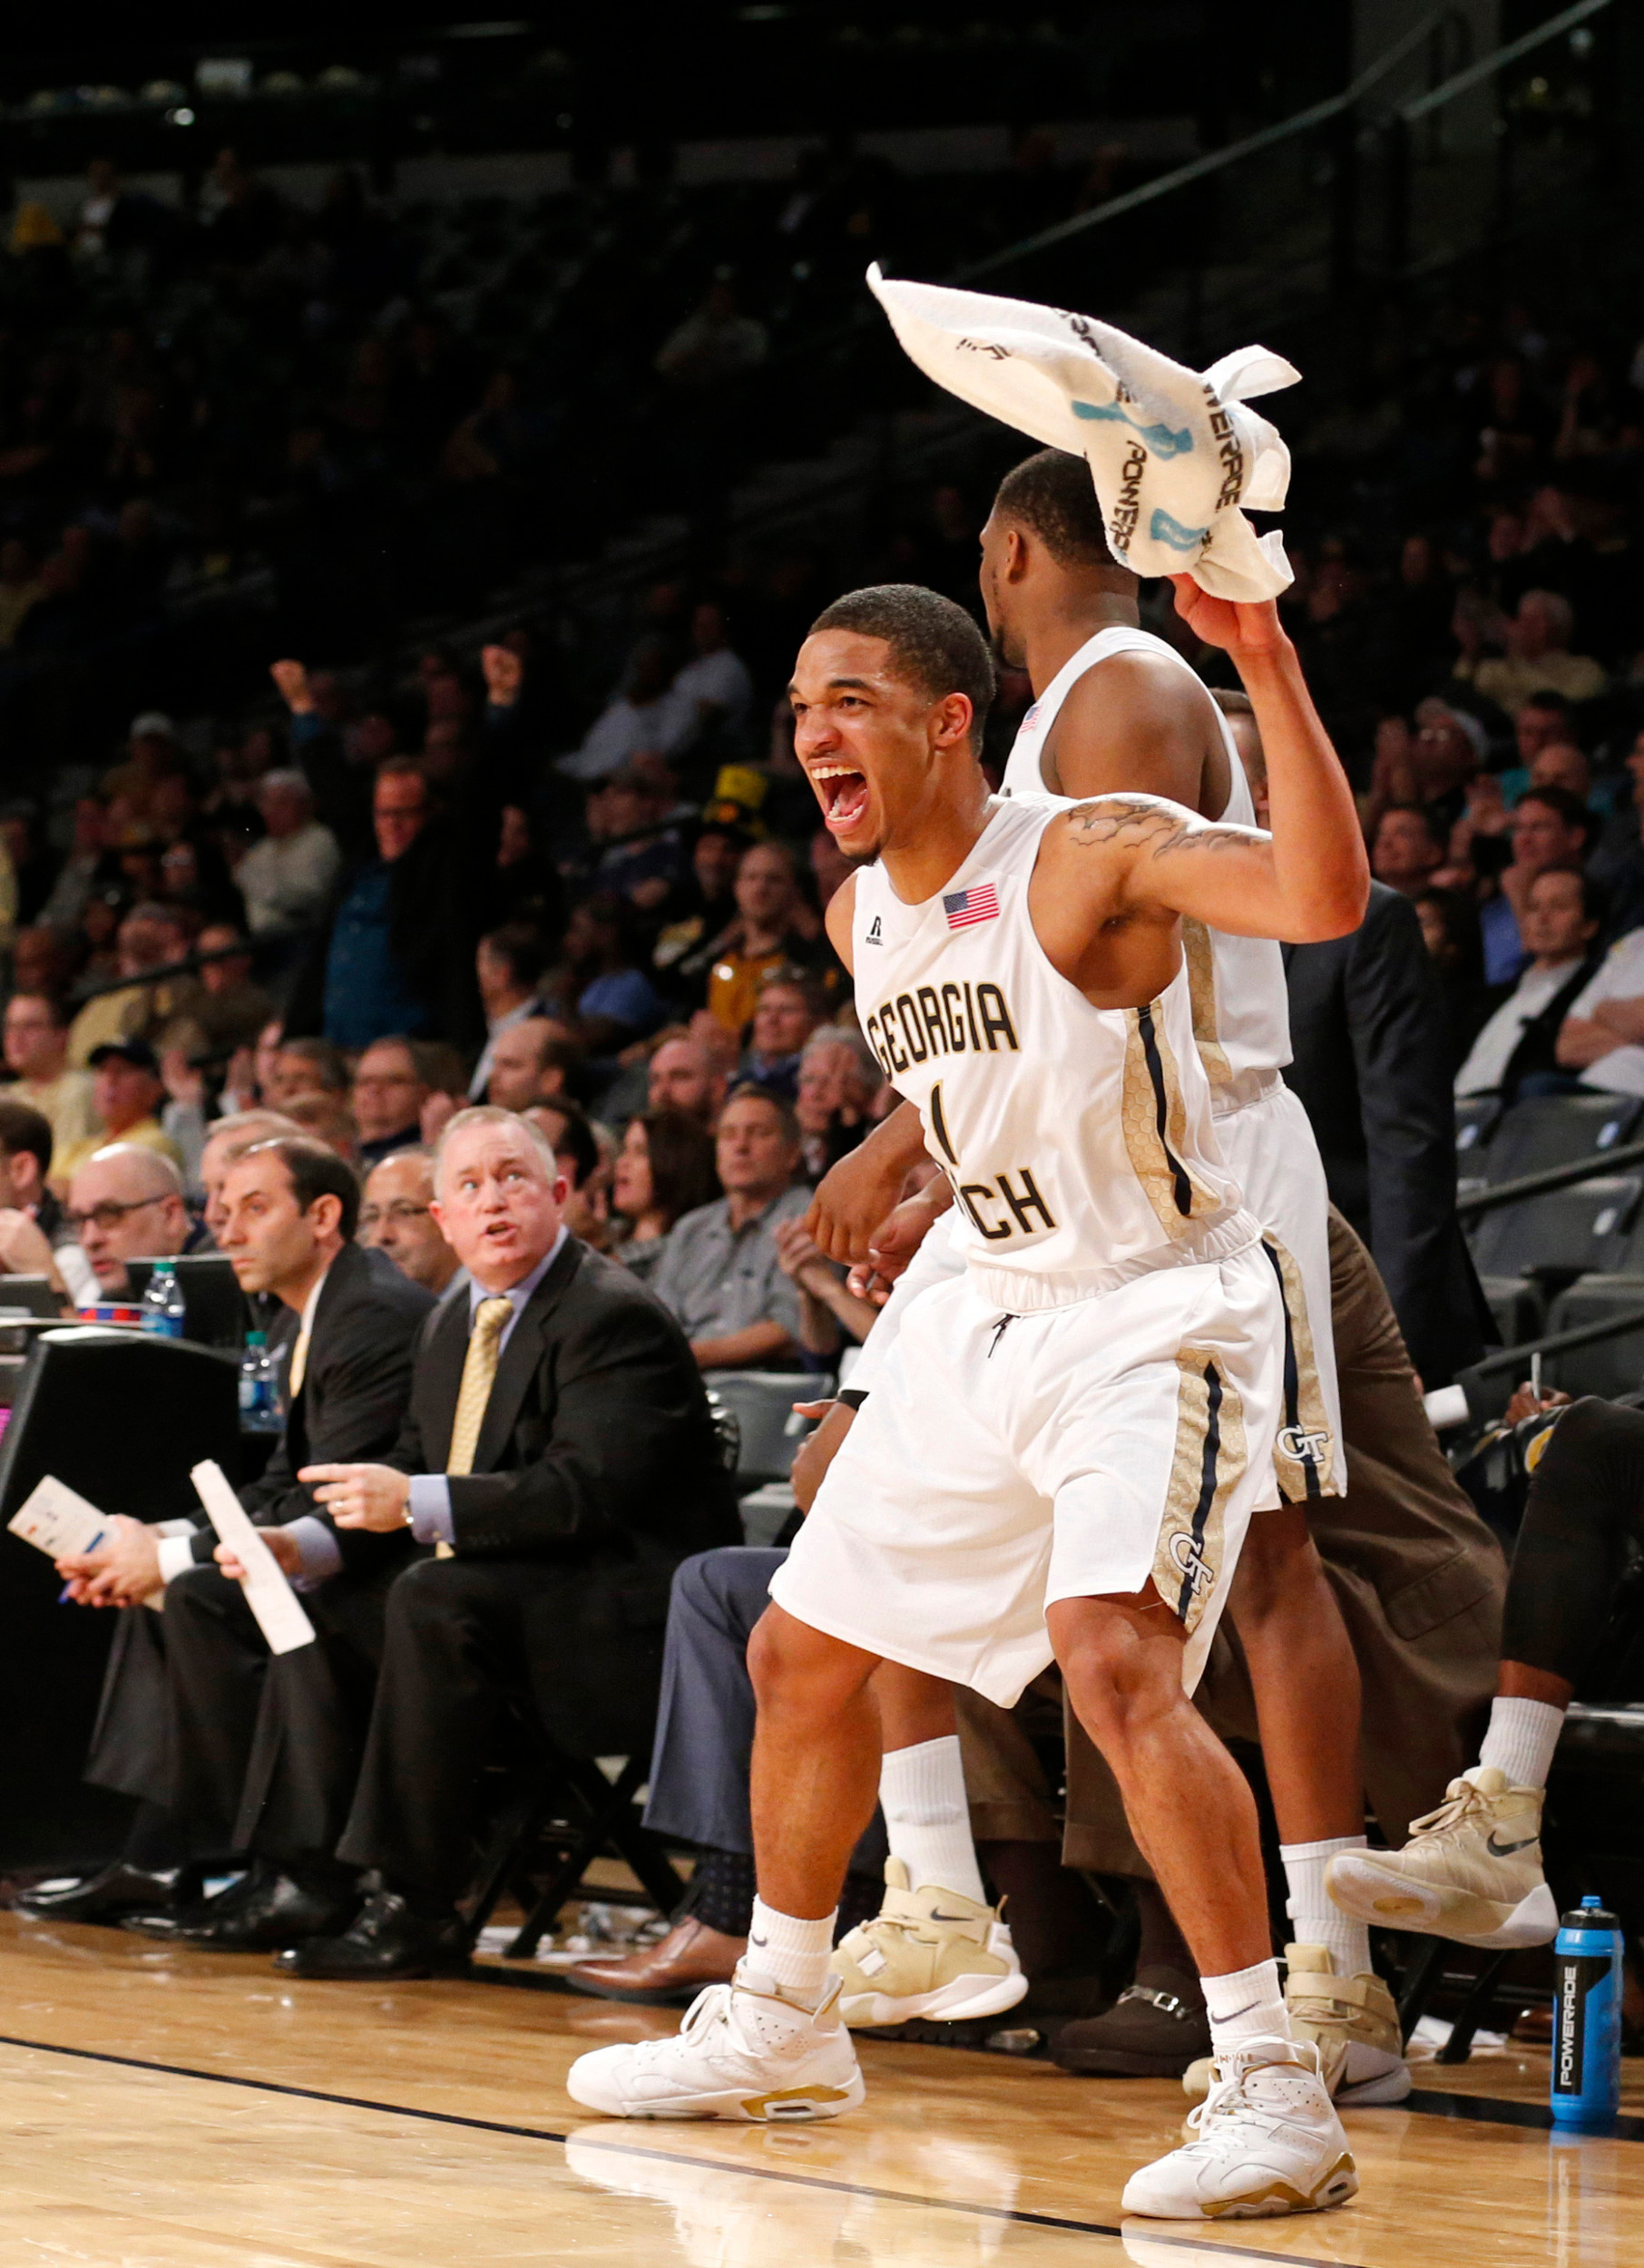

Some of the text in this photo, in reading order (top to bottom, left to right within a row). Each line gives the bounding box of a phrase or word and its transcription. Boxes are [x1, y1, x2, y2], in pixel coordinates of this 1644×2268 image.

[866, 981, 1022, 1086] GEORGIA
[959, 1167, 1060, 1241] CH
[1276, 1424, 1329, 1463] GT
[1169, 1531, 1215, 1595] GT
[1560, 1965, 1578, 2087] POWERADE
